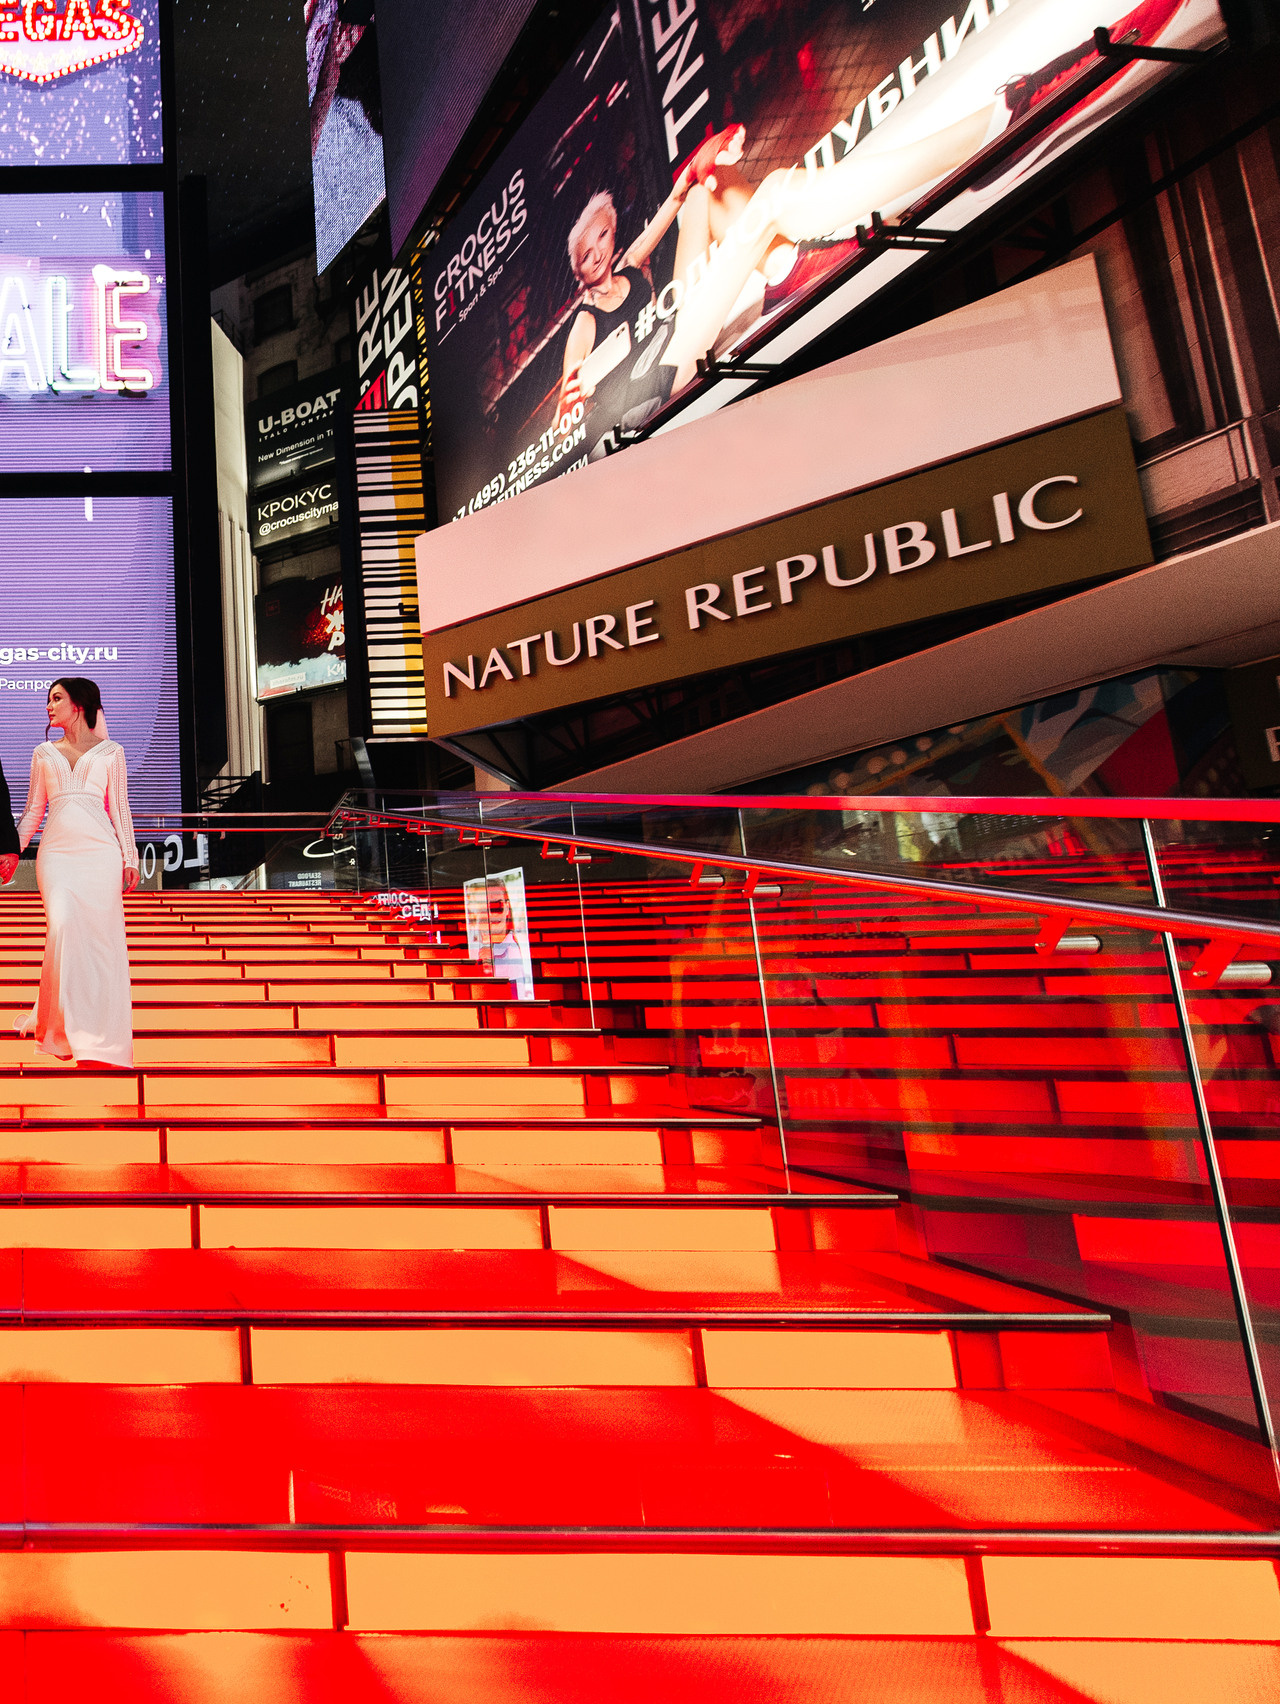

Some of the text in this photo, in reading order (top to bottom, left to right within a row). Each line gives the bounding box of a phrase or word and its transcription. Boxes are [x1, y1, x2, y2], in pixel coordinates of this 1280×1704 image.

[434, 169, 525, 301] CROCUS
[458, 293, 478, 322] Sport
[487, 264, 504, 288] Spa
[258, 388, 341, 434] U-BOAT
[259, 428, 288, 442] ITALO
[258, 451, 274, 463] New
[276, 437, 315, 456] Dimension
[468, 473, 506, 515] (495)
[507, 402, 584, 482] 236-11-00
[259, 501, 339, 536] @crocuscityma
[443, 474, 1084, 698] NATURE REPUBLIC
